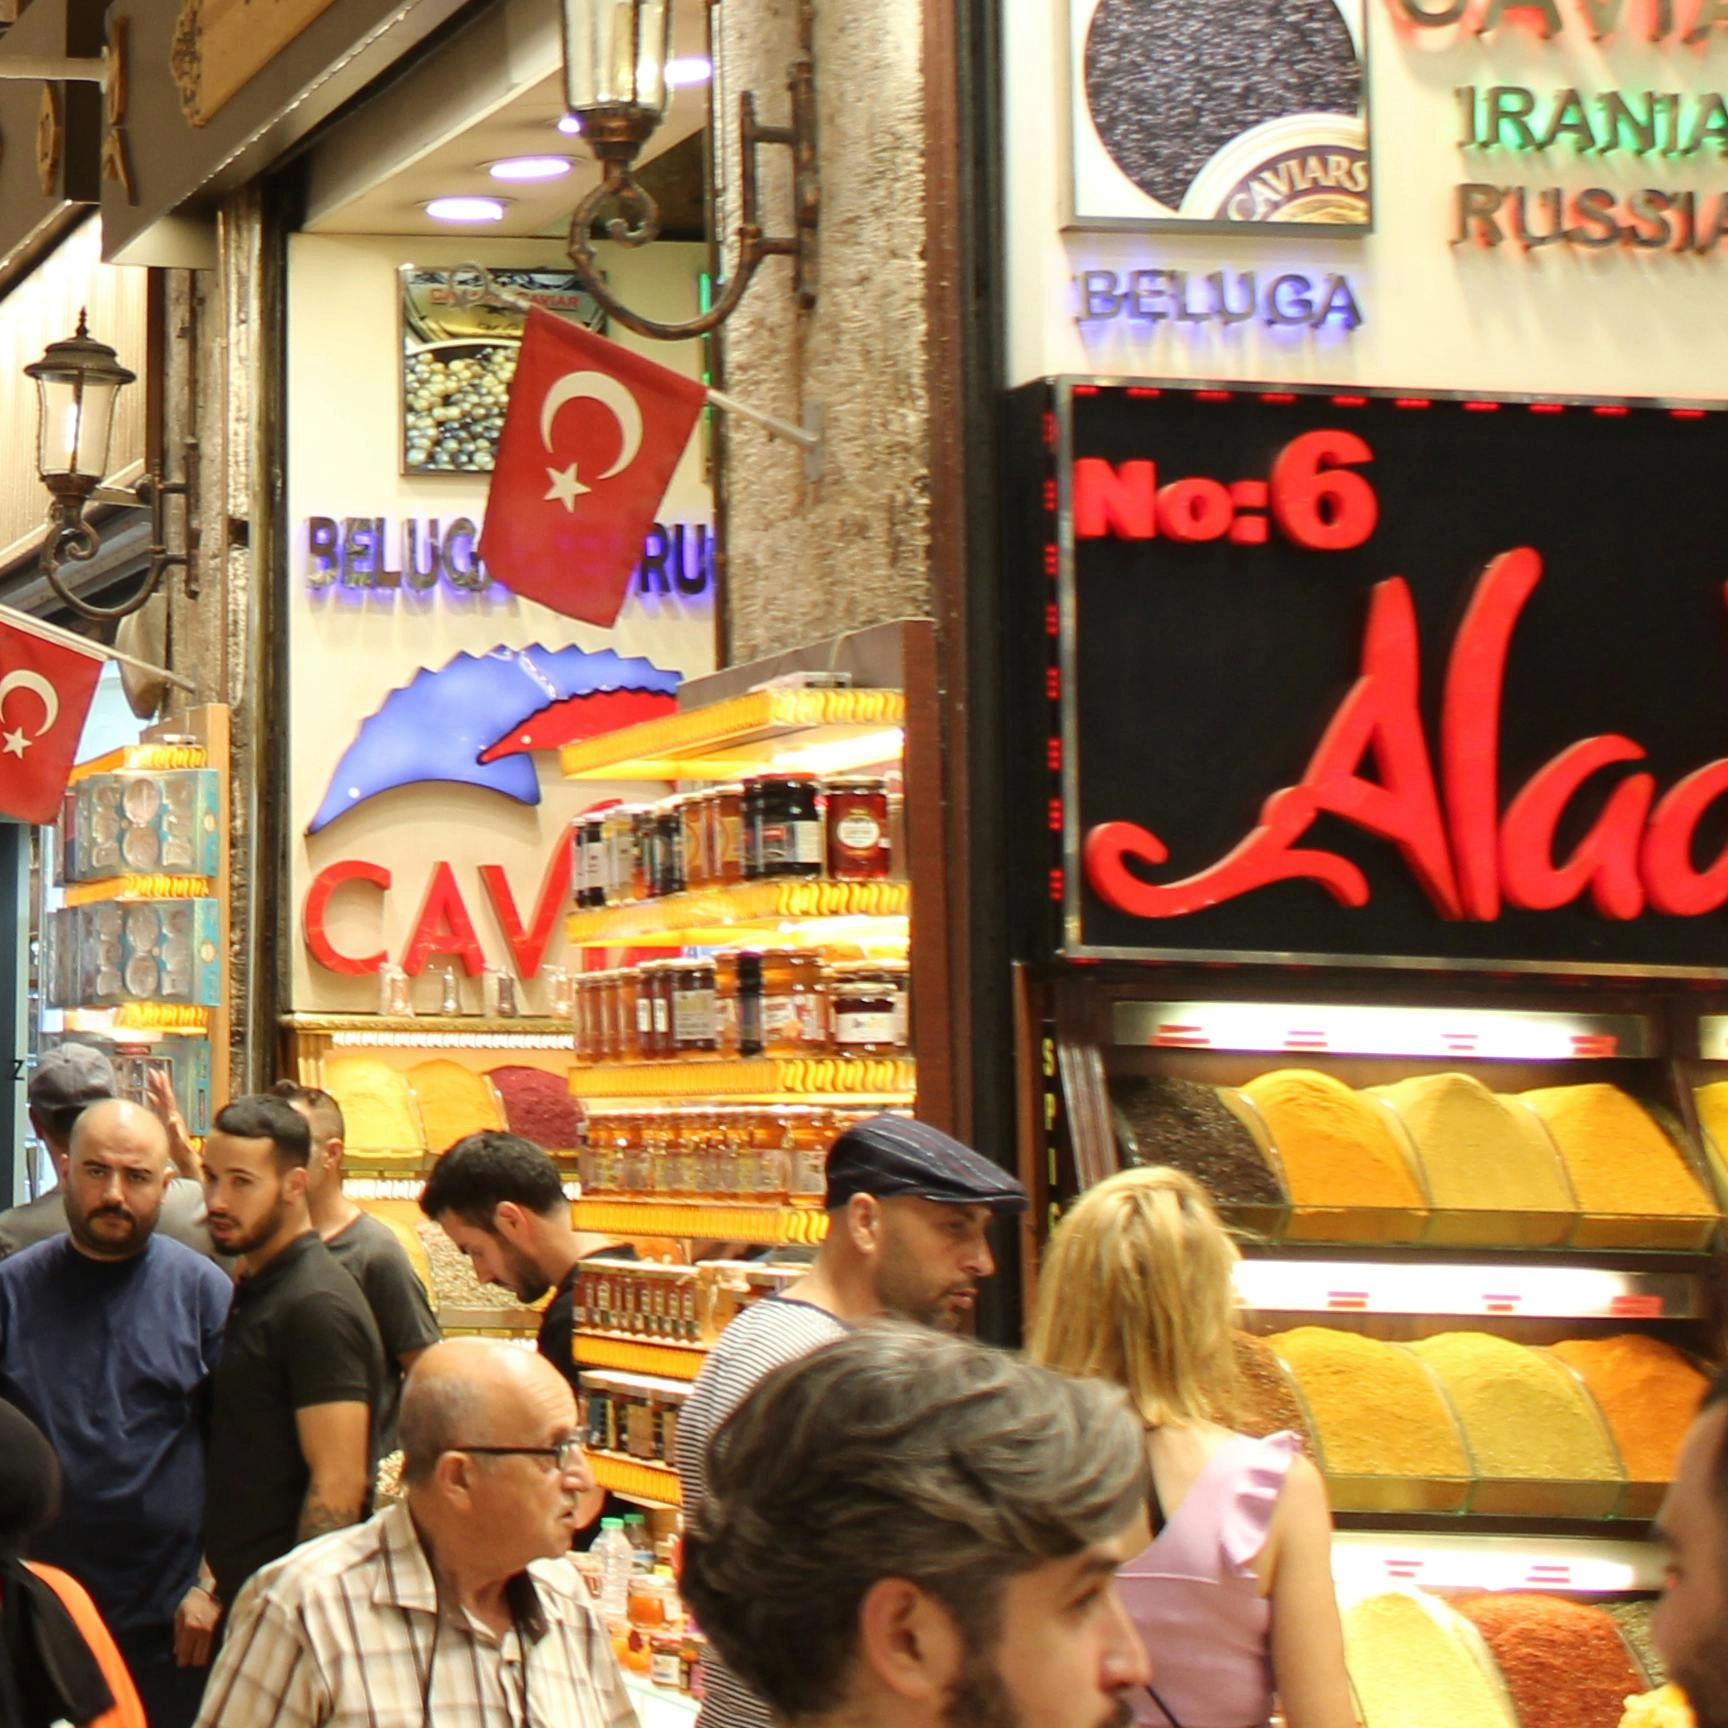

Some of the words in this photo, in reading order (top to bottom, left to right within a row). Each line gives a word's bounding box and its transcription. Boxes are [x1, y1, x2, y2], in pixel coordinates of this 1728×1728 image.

[1073, 269, 1364, 331] BELUGA
[1073, 429, 1378, 550] No:6
[303, 516, 491, 591] BELUG
